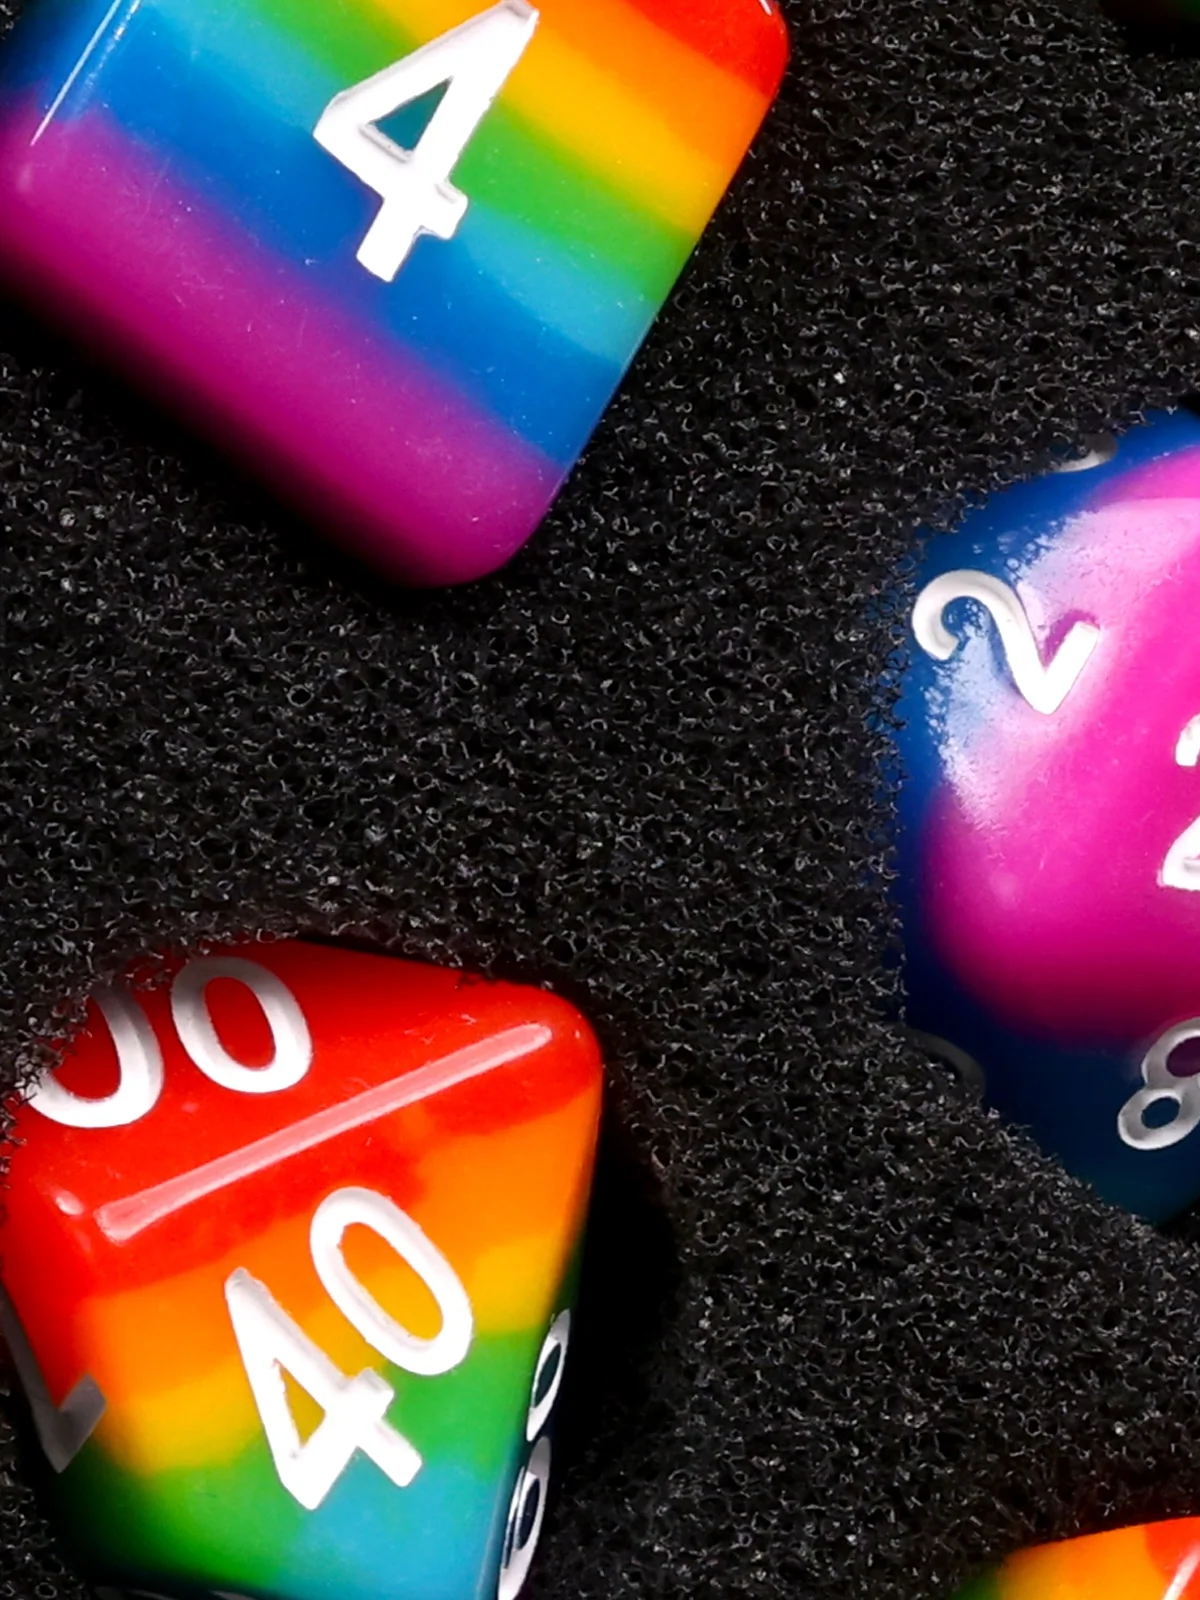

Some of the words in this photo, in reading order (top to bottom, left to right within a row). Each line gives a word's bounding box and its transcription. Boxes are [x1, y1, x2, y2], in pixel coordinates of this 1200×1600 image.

[313, 0, 539, 282] 4
[912, 570, 1099, 715] 2
[224, 1186, 475, 1511] 40
